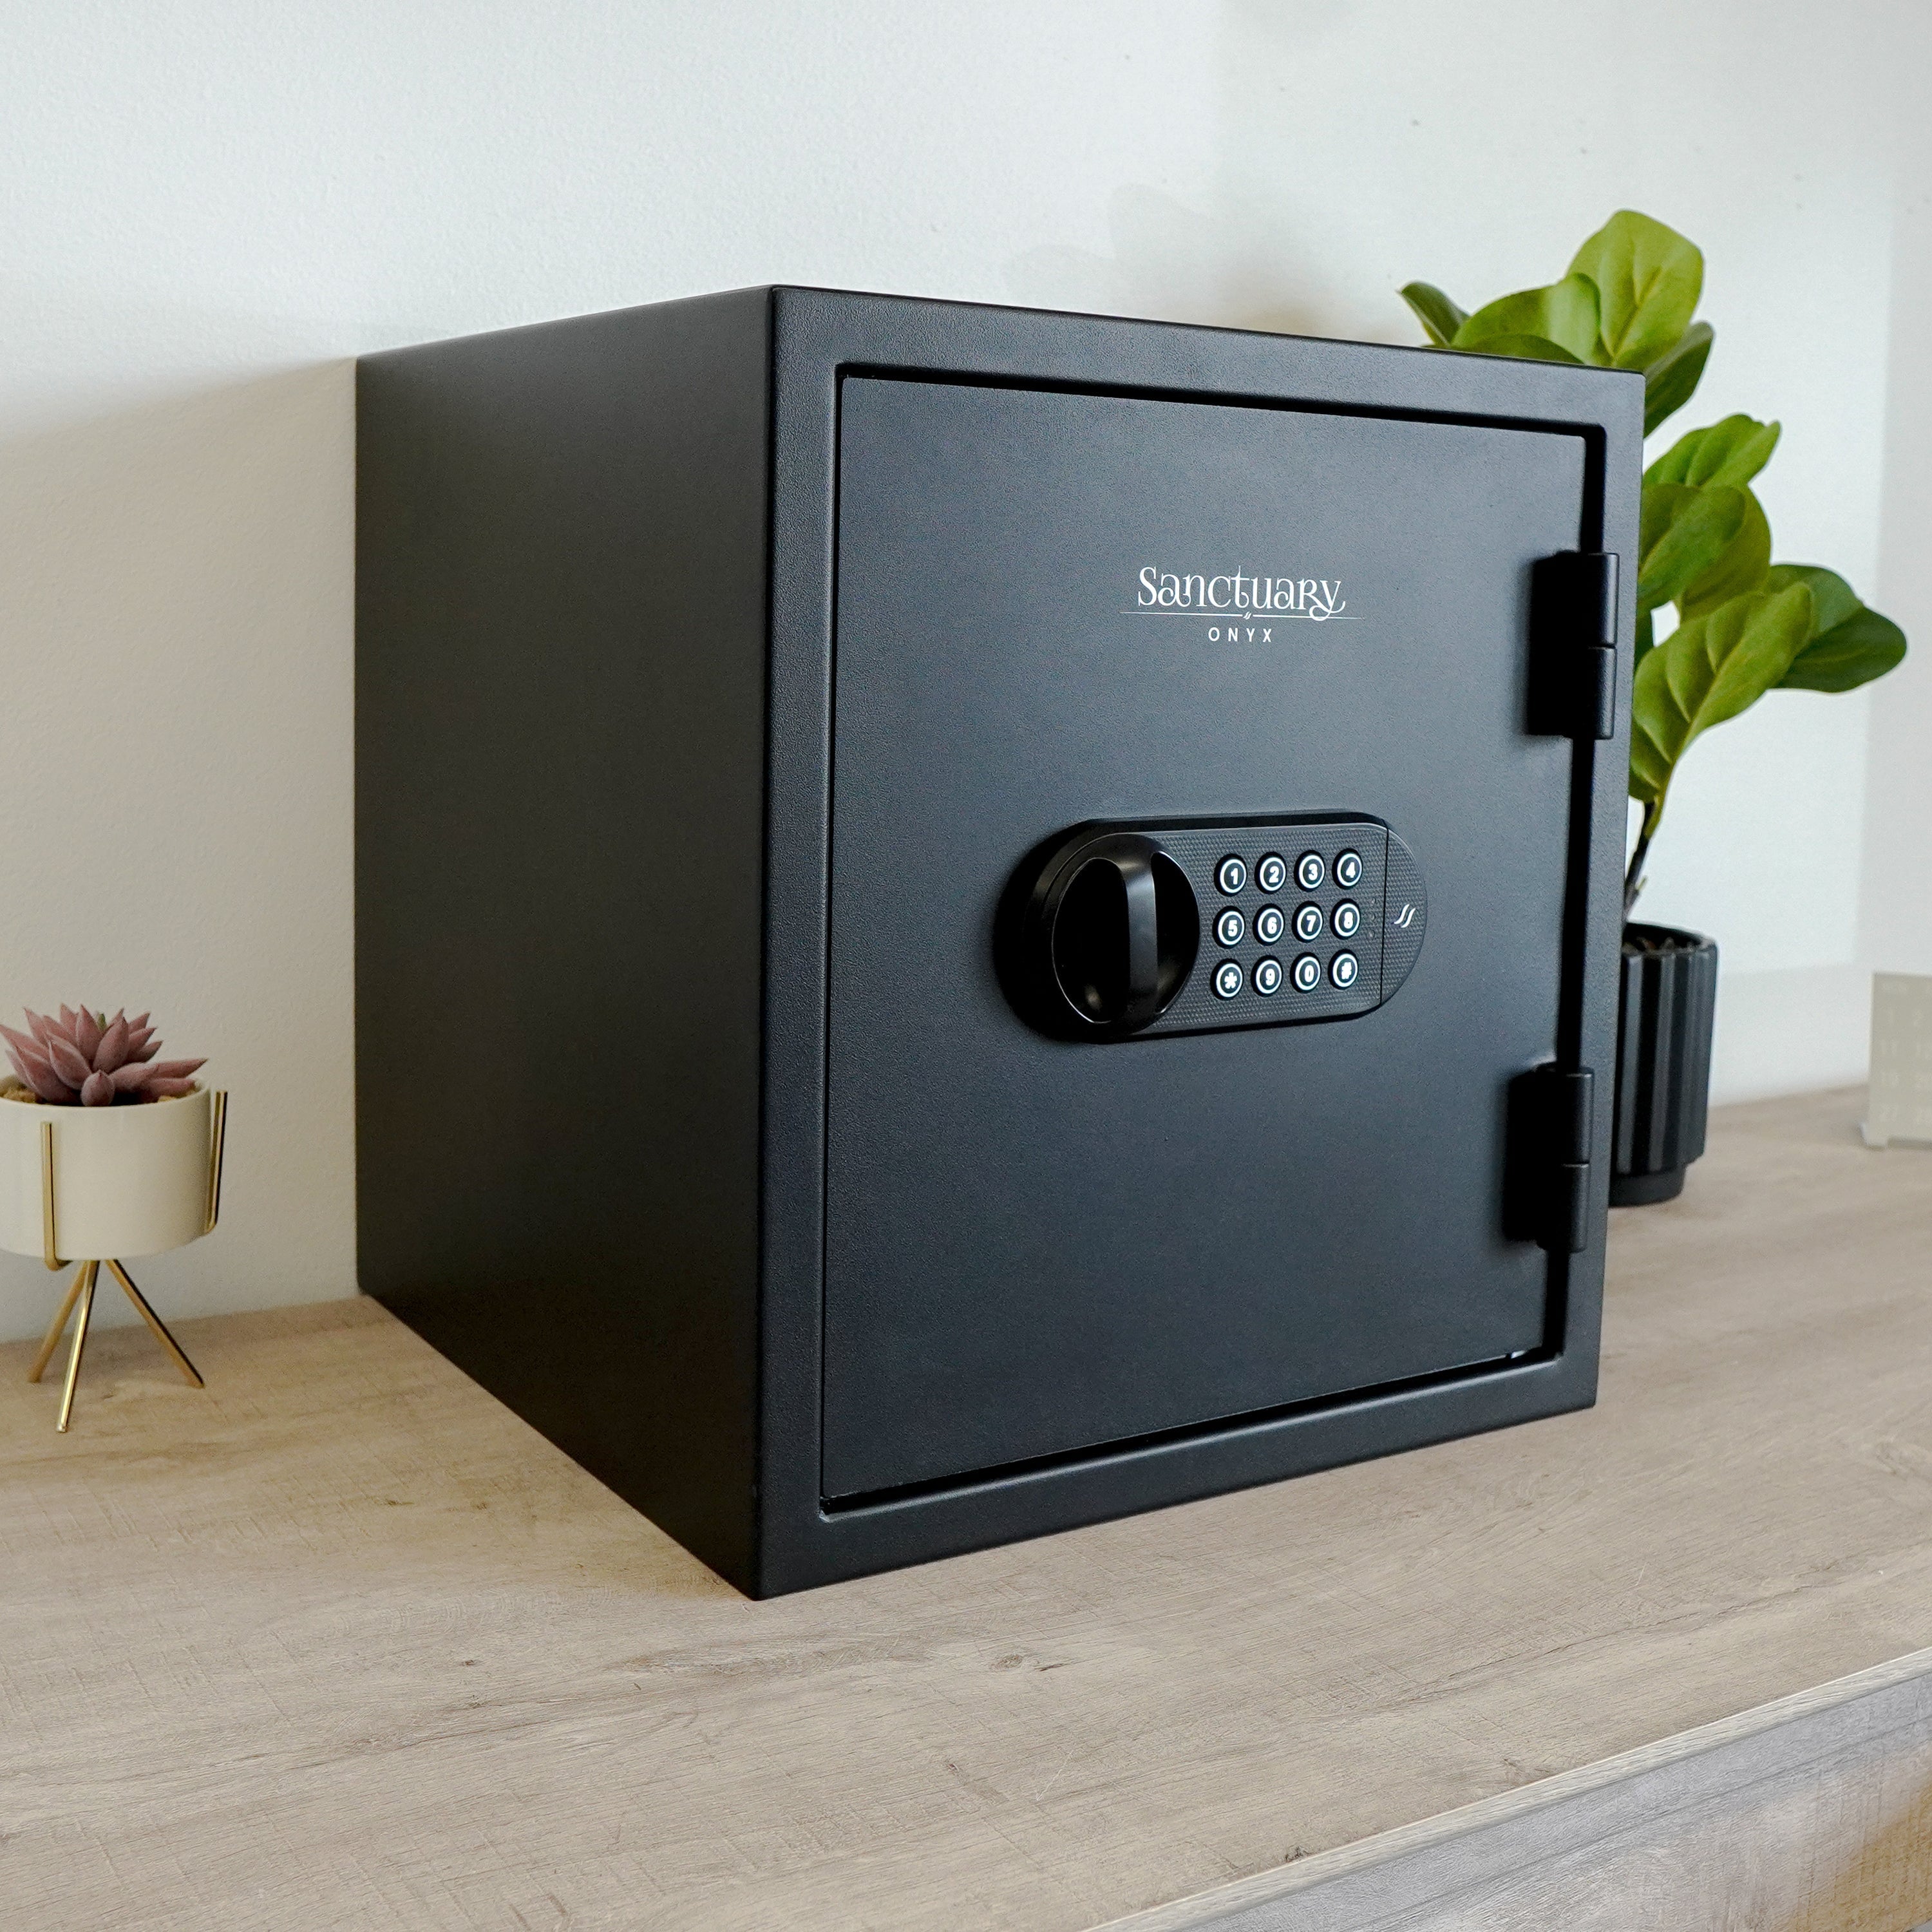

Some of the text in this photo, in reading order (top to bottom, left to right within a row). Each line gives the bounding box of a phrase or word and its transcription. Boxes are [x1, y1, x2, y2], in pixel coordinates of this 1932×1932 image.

[1138, 565, 1346, 621] Sanctuary
[1208, 627, 1272, 643] ONYX
[1231, 862, 1356, 886] 1 2 3 4
[1228, 911, 1354, 937] 5 6 7 8
[1265, 969, 1276, 986] 9
[1305, 965, 1314, 983] 0
[1341, 962, 1352, 980] #
